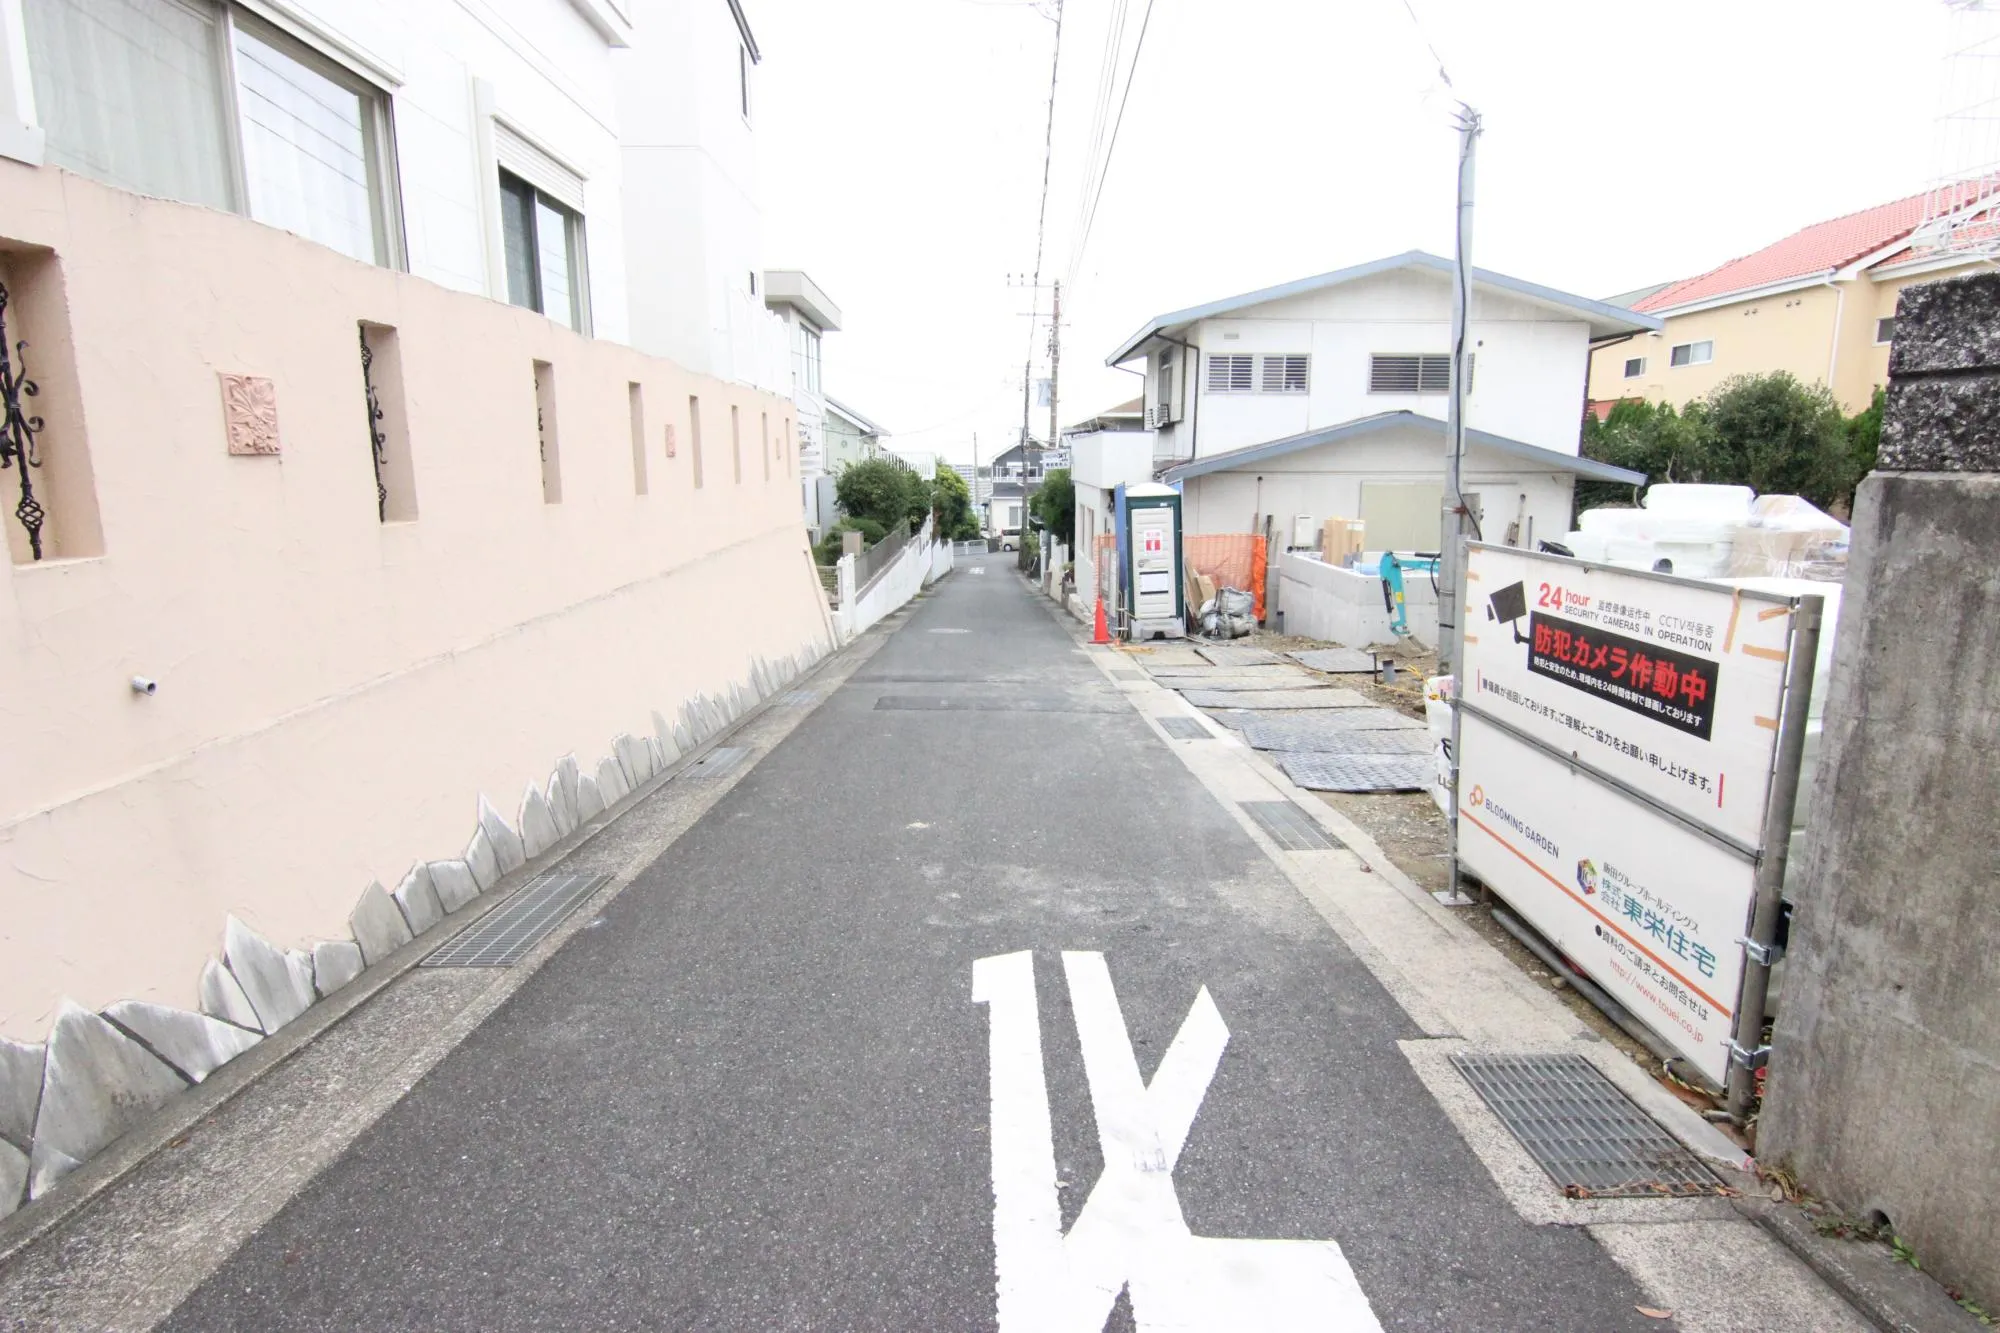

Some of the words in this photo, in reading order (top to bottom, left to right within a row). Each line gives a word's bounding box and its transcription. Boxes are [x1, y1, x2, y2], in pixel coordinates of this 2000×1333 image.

[1537, 582, 1563, 610] 24
[1565, 589, 1591, 607] hour
[1564, 605, 1598, 621] SECURITY
[1602, 615, 1640, 633] CAMERAS
[1644, 626, 1653, 637] IN
[1658, 629, 1712, 652] OPERATION
[1534, 622, 1708, 708] 防犯カメラ作動中
[1485, 797, 1524, 834] BLOOMING
[1525, 826, 1559, 859] GARDEN
[1622, 893, 1716, 979] 東栄住宅
[1609, 957, 1704, 1044] http://www.touei.co.jp
